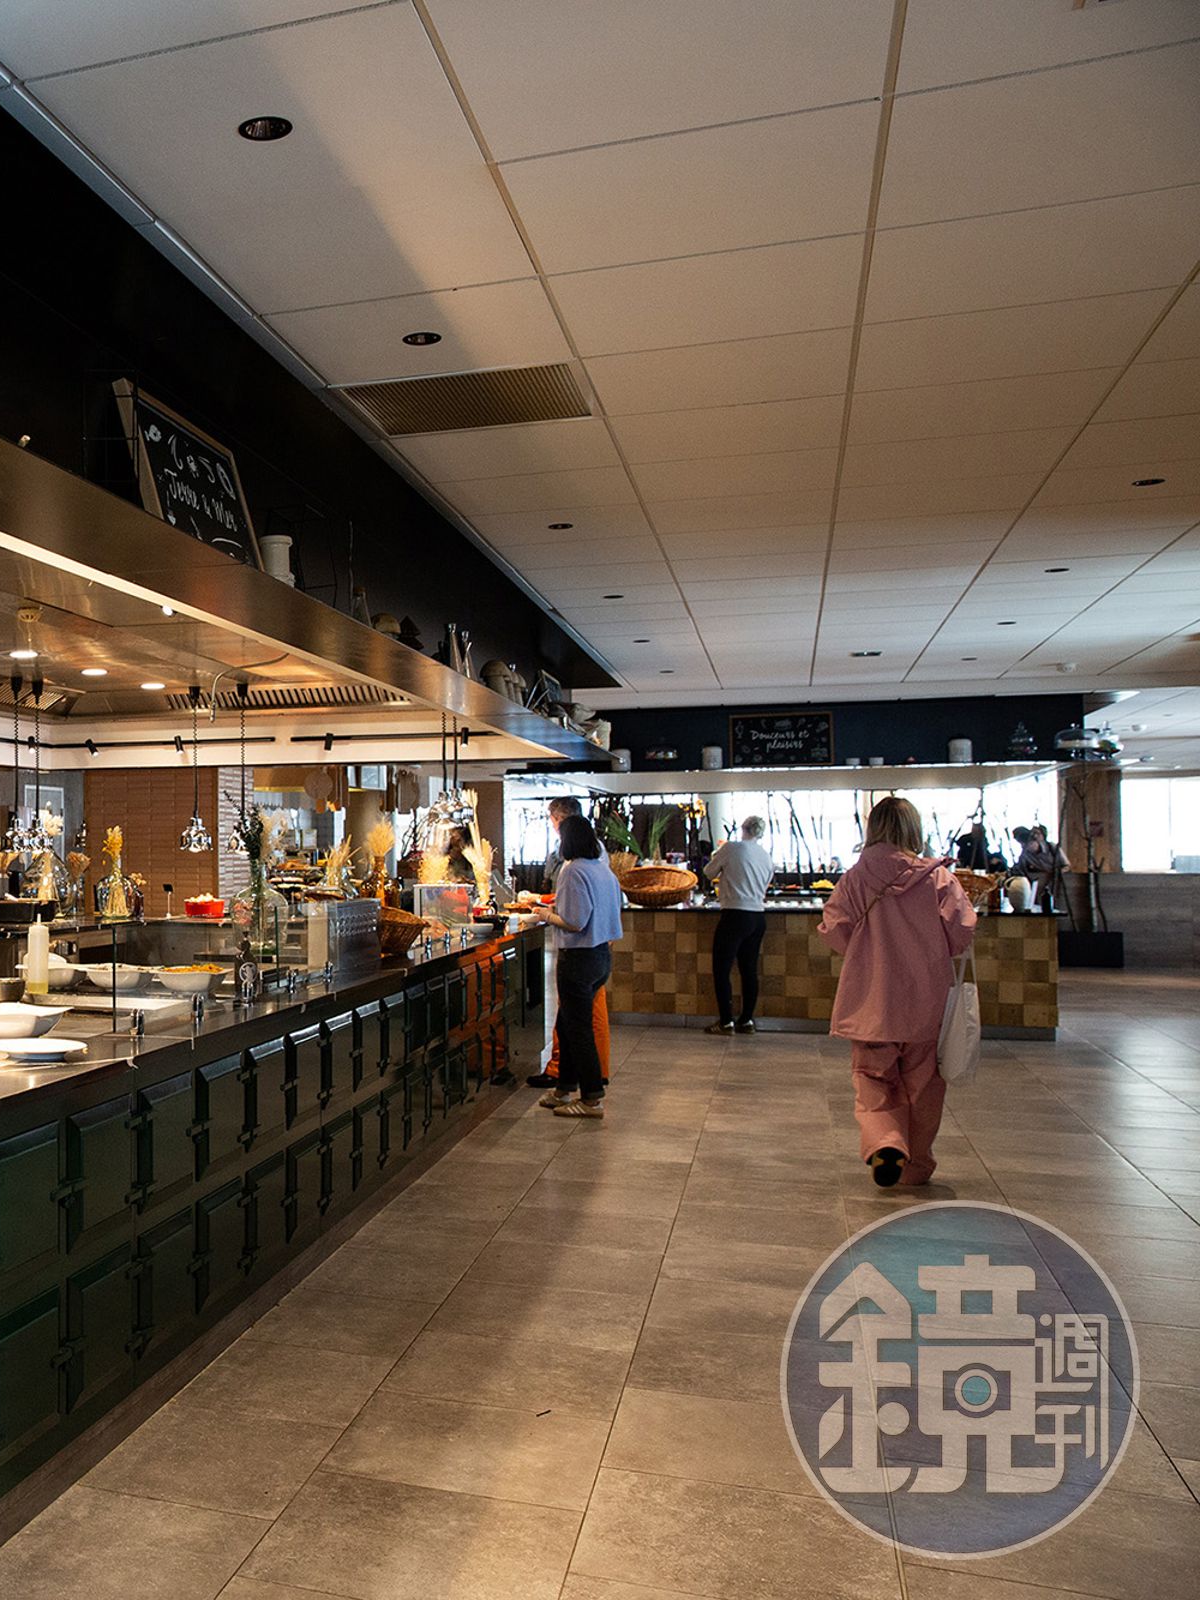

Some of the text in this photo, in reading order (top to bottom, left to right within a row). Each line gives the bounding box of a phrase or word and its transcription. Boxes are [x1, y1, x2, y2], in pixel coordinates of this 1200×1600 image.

[750, 729, 809, 740] Douceurs et
[766, 740, 804, 753] plaisirs
